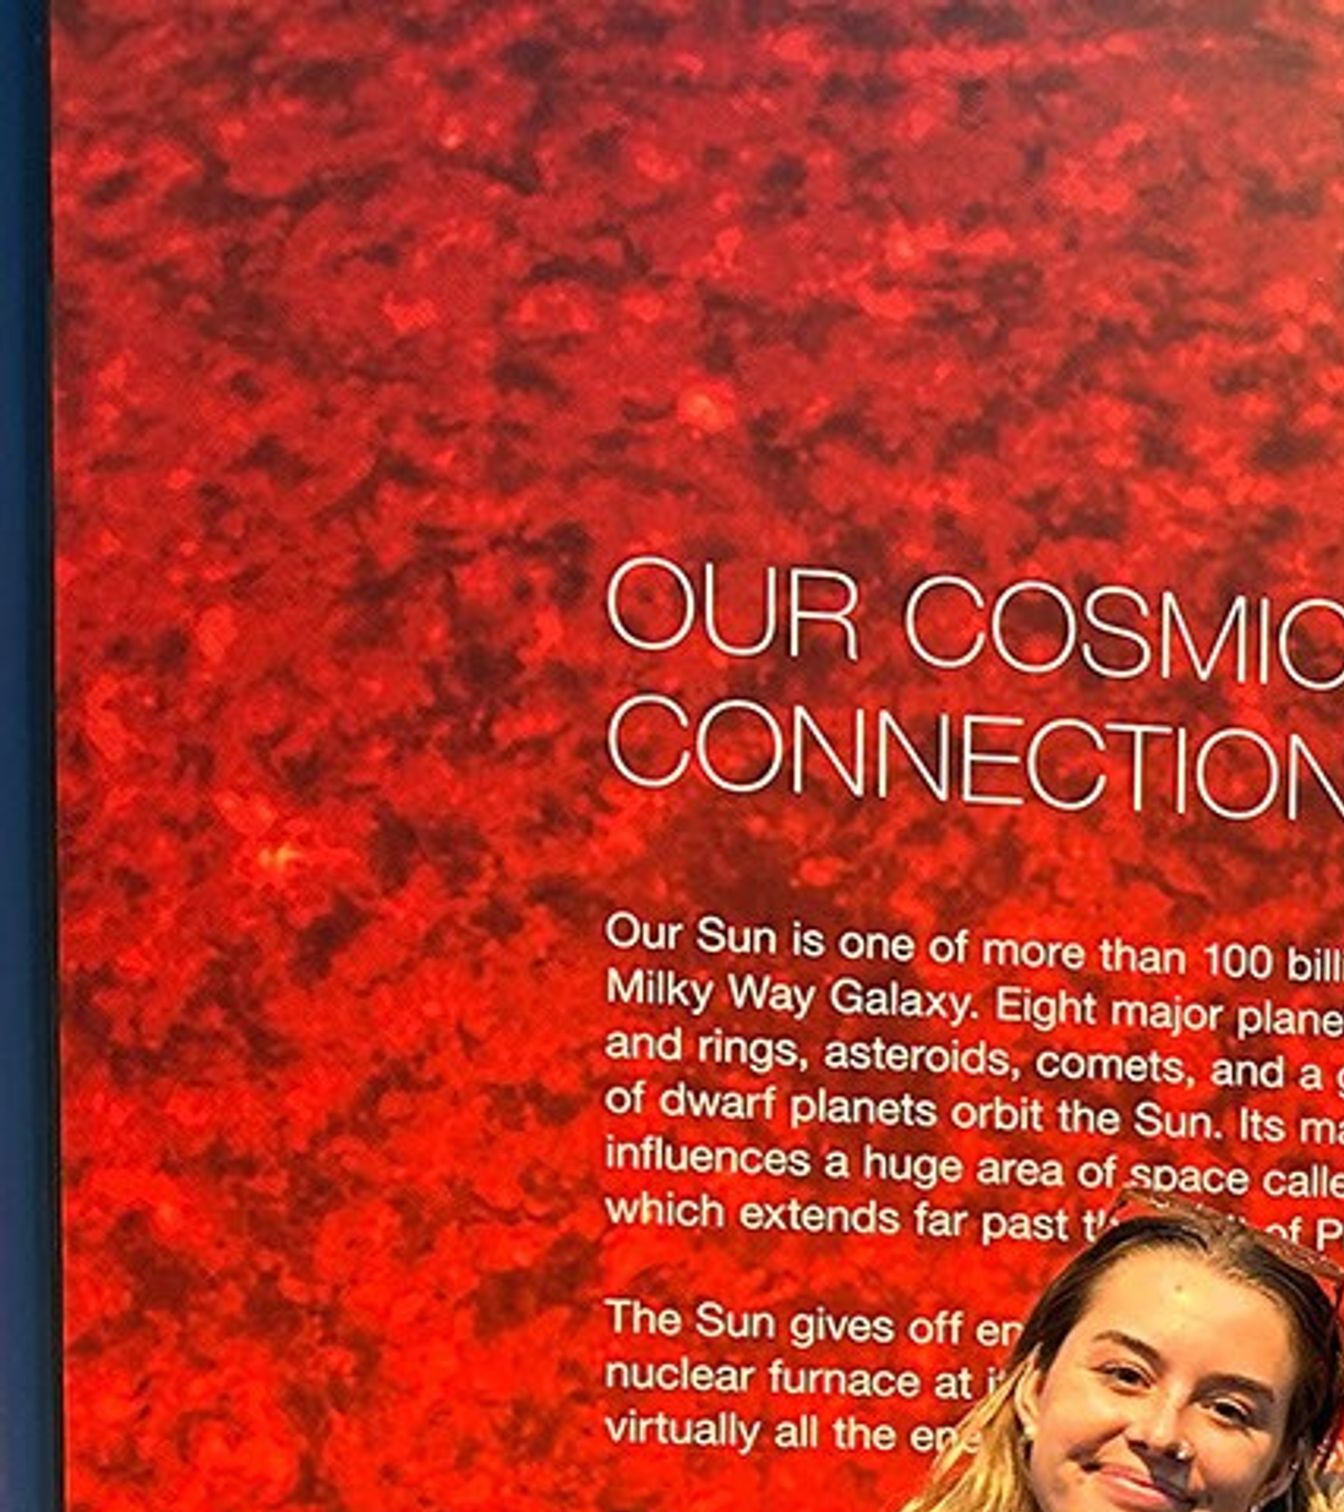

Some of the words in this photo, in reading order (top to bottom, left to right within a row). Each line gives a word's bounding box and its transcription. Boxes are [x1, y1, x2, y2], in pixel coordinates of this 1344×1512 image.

[607, 556, 858, 660] OUR
[607, 912, 682, 949] Our
[697, 917, 776, 953] Sun
[794, 922, 824, 956] is
[840, 933, 914, 961] one
[930, 930, 968, 962] of
[984, 940, 1084, 969] more
[1100, 939, 1185, 973] than
[1206, 944, 1272, 979] 100
[609, 968, 713, 1015] Milky
[729, 974, 815, 1019] Way
[831, 979, 977, 1026] Galaxy.
[998, 987, 1096, 1031] Eight
[1113, 997, 1223, 1036] major
[606, 1027, 681, 1060] and
[700, 1028, 807, 1073] rings,
[825, 1038, 1019, 1080] asteroids,
[1037, 1052, 1193, 1086] comets,
[1212, 1056, 1283, 1087] and
[1300, 1065, 1321, 1089] a
[606, 1081, 645, 1113] of
[661, 1082, 775, 1118] dwarf
[792, 1088, 936, 1127] planets
[952, 1097, 1042, 1131] orbit
[1058, 1100, 1119, 1134] the
[1135, 1102, 1221, 1138] Sun.
[1241, 1108, 1284, 1141] Its
[608, 1135, 810, 1176] influences
[825, 1151, 848, 1177] a
[865, 1145, 962, 1185] huge
[978, 1158, 1063, 1185] area
[1078, 1155, 1116, 1187] of
[1129, 1164, 1249, 1197] space
[606, 1192, 723, 1226] which
[741, 1200, 899, 1233] extends
[915, 1202, 969, 1237] far
[982, 1212, 1069, 1245] past
[605, 1298, 680, 1336] The
[697, 1302, 775, 1338] Sun
[791, 1306, 894, 1349] gives
[909, 1310, 963, 1344] off
[606, 1357, 756, 1392] nuclear
[769, 1358, 920, 1398] furnace
[935, 1368, 972, 1400] at
[605, 1410, 761, 1455] virtually
[776, 1412, 817, 1448] all
[834, 1418, 896, 1450] the
